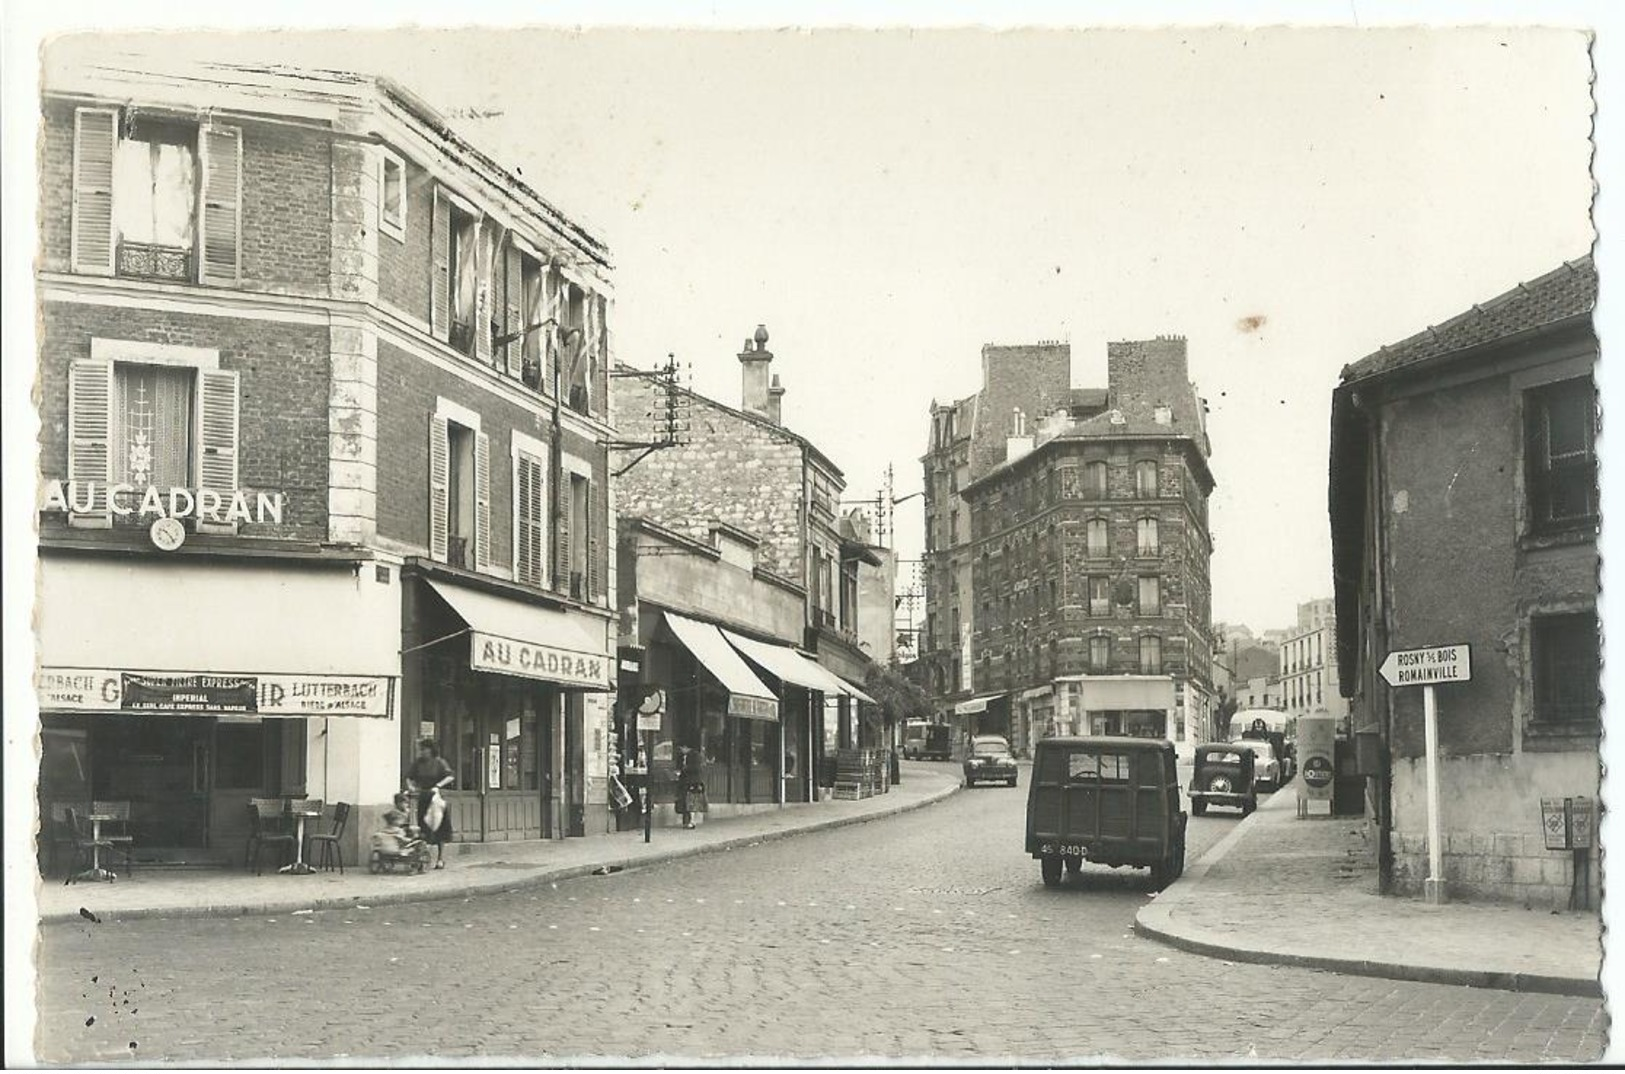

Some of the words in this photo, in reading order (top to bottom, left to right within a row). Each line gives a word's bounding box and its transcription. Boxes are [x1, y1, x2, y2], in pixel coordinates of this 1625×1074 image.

[41, 479, 95, 513] AU
[106, 483, 282, 524] CADRAN
[483, 641, 511, 665] AU
[520, 647, 601, 679] CADRAN
[1398, 652, 1425, 666] ROSNY
[1438, 649, 1457, 663] BOIS
[1399, 665, 1458, 682] ROMAINVILLE
[201, 677, 239, 689] EXPRESS
[292, 682, 377, 698] LUTTERBACH
[172, 693, 209, 703] IMPERIAL
